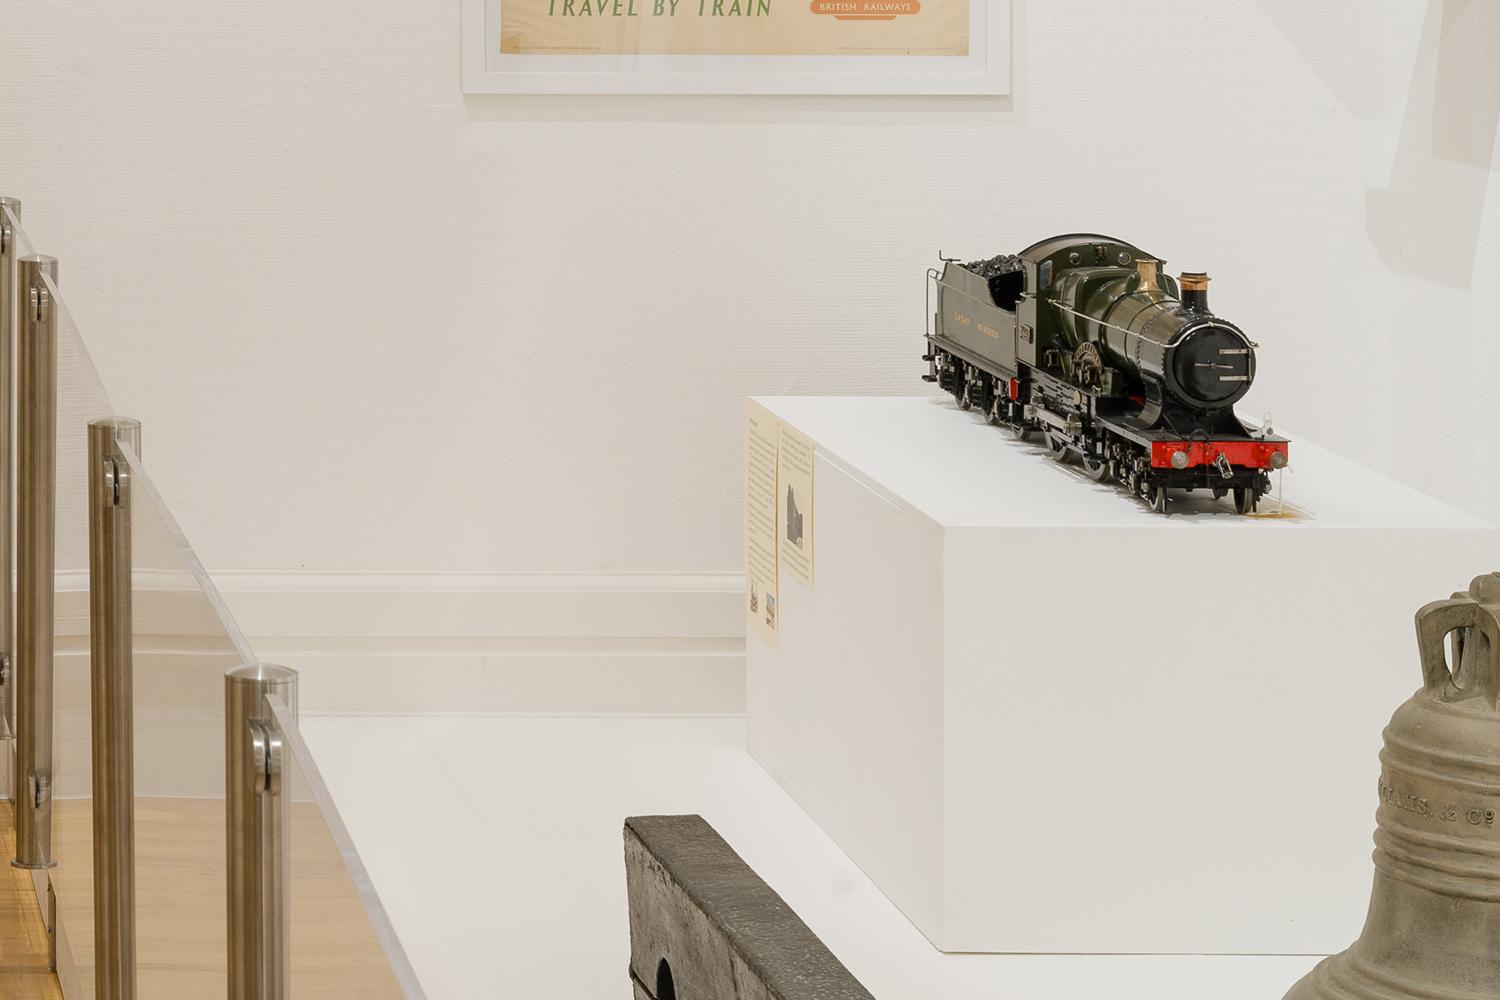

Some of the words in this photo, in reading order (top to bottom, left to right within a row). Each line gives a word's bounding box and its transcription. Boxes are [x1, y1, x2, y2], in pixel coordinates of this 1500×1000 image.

[819, 3, 857, 11] BRITISH
[864, 3, 911, 11] RAILWAYS
[954, 312, 970, 326] GREAT
[977, 323, 999, 339] WESTERN
[1440, 804, 1458, 823] &
